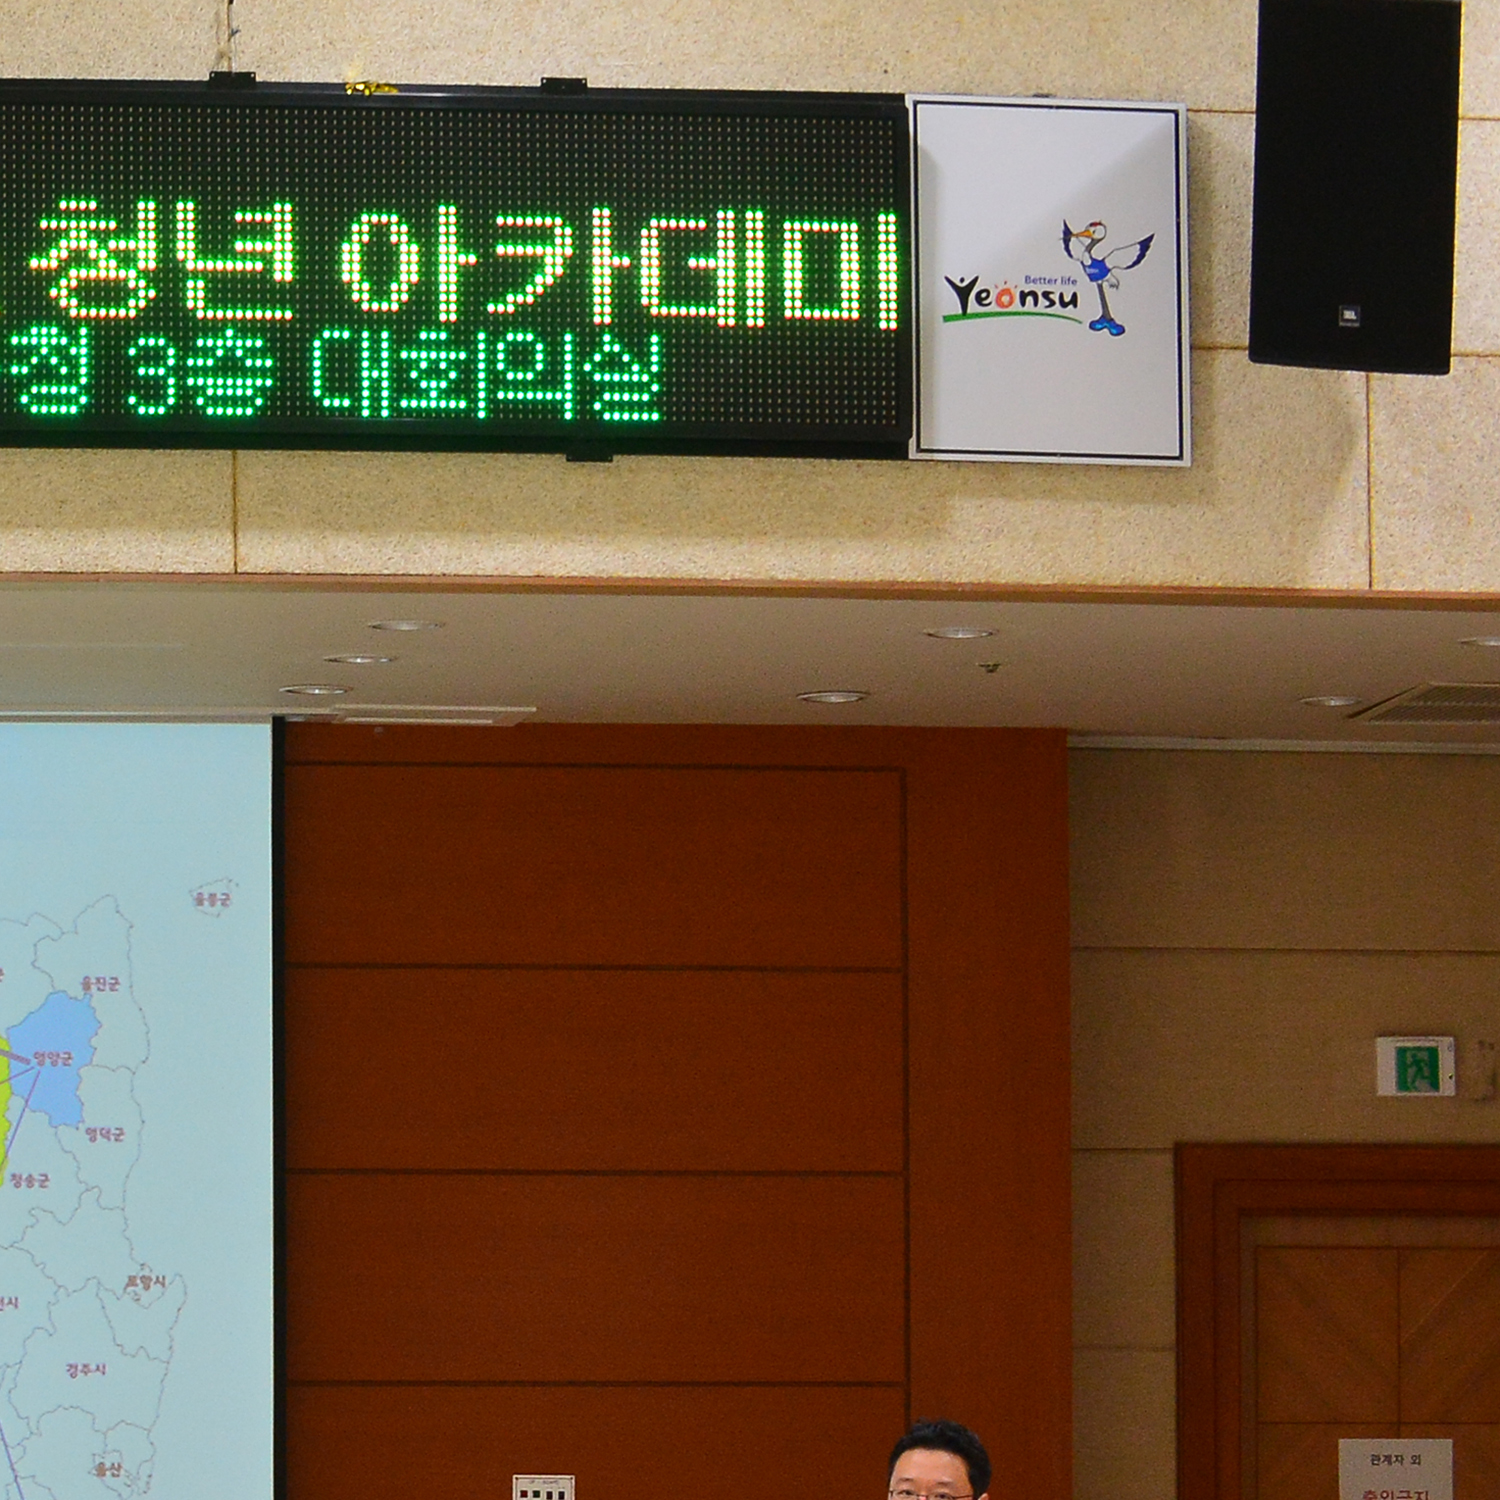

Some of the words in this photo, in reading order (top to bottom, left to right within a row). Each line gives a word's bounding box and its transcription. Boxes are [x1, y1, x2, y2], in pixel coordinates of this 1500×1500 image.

[36, 197, 297, 322] 청년
[339, 202, 901, 329] 아카데미
[1024, 275, 1057, 286] Better
[1060, 274, 1078, 286] life
[943, 275, 1079, 316] Yeonsu
[125, 329, 277, 420] 3층
[310, 328, 663, 423] 대회의실
[66, 1363, 107, 1379] 경주시
[1370, 1453, 1405, 1466] 관계자
[1410, 1453, 1422, 1466] 외
